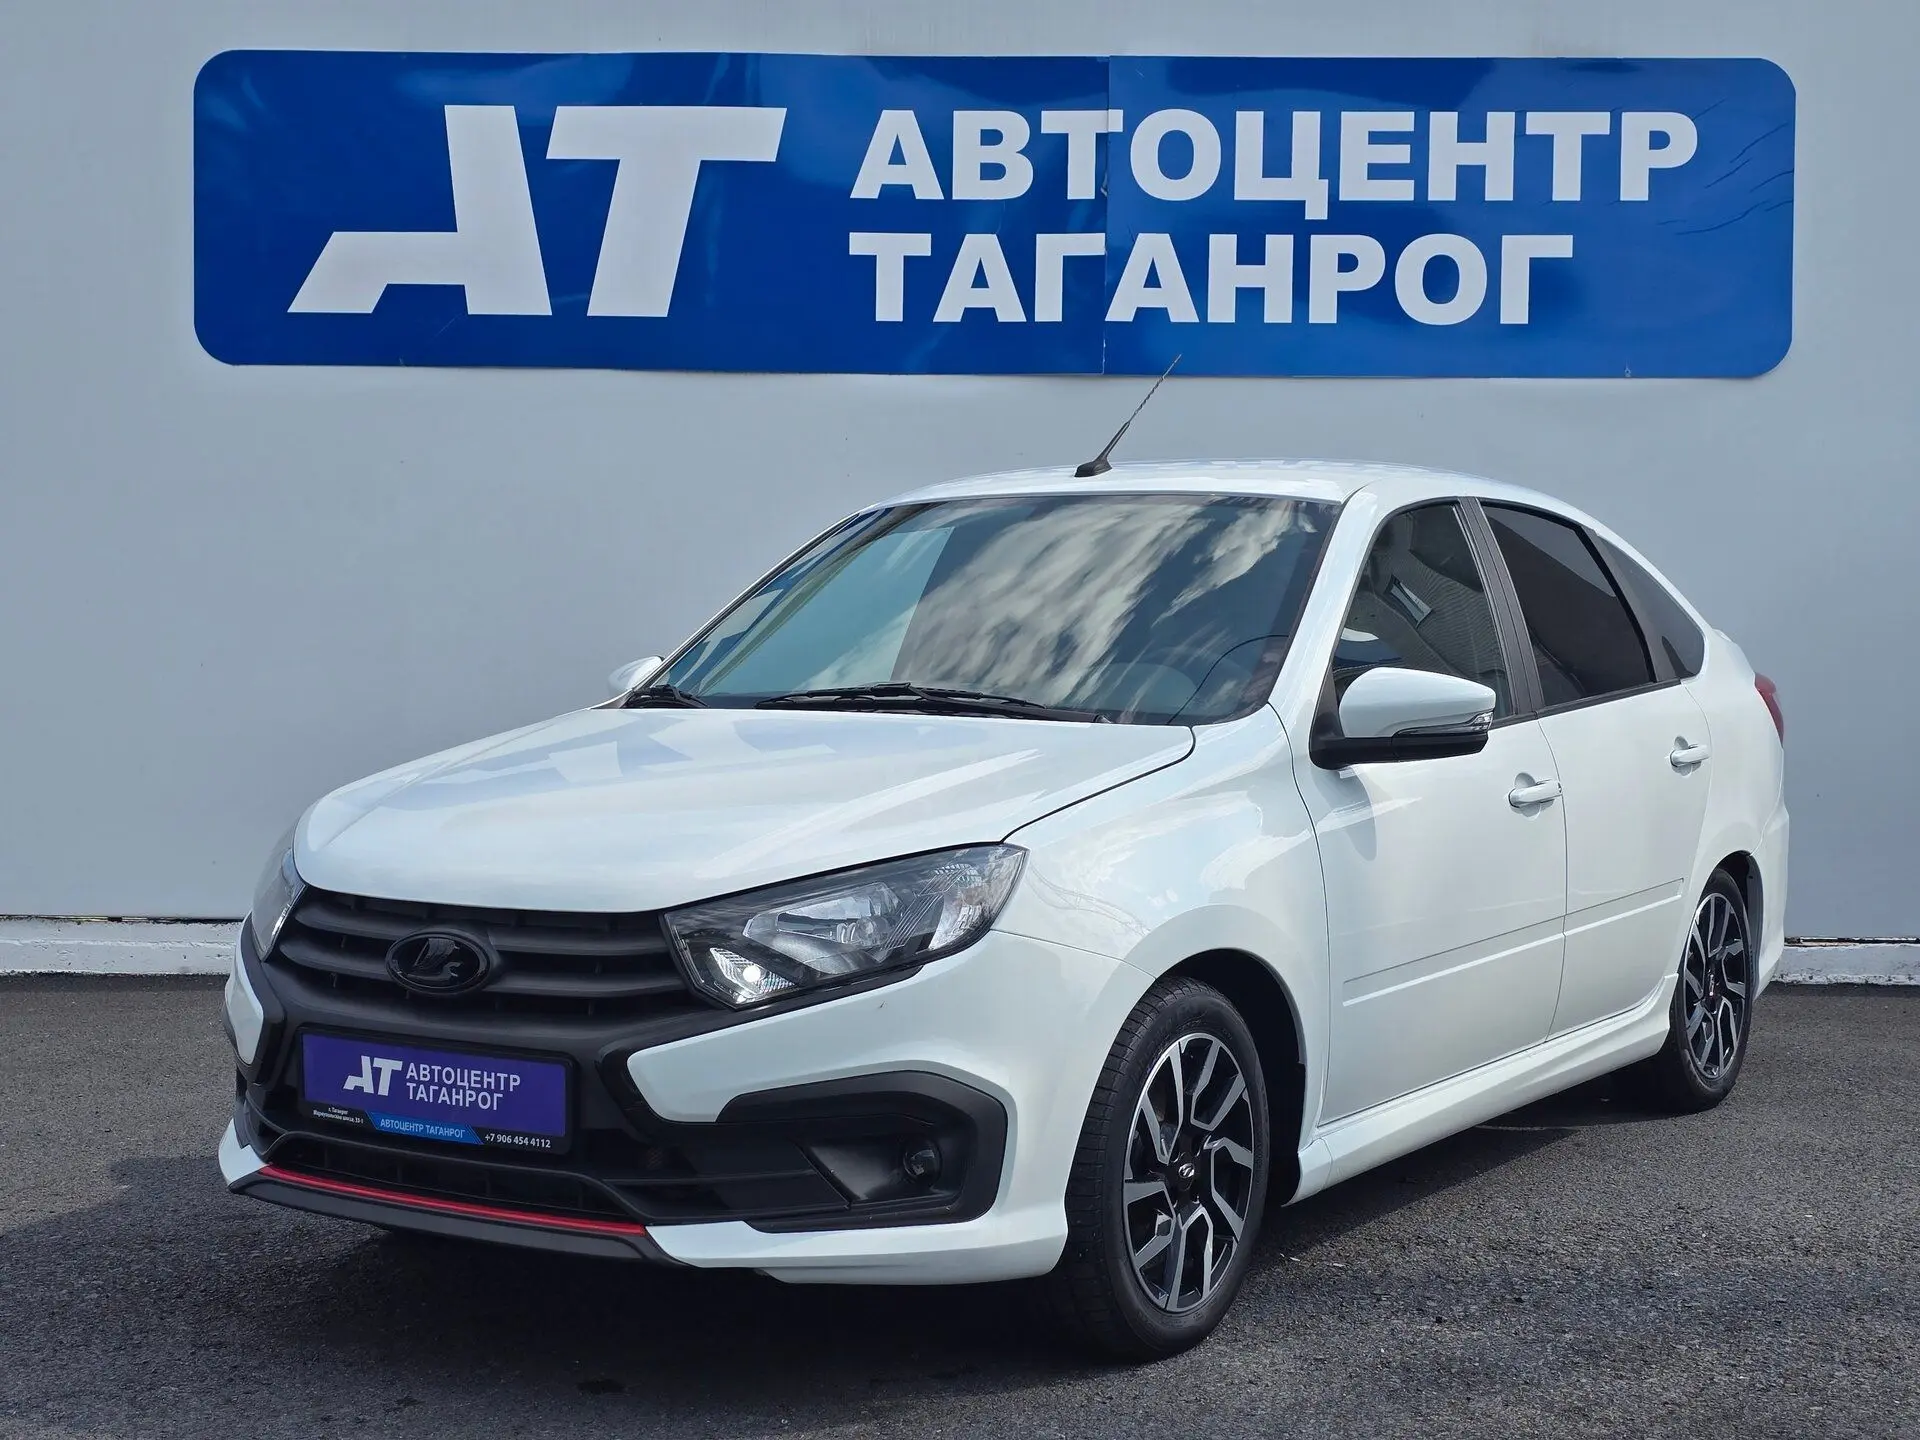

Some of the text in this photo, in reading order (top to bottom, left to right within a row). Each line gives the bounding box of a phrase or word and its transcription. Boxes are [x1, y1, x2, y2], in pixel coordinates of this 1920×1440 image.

[849, 108, 1699, 221] АВТОЦЕНТР
[287, 105, 788, 317] АТ
[849, 232, 1574, 326] ТАГАНРОГ
[406, 1062, 521, 1092] АВТОЦЕНТР
[406, 1083, 504, 1111] ТАГАНРОГ
[380, 1118, 466, 1139] АВТОЦЕНТР ТАГАНРОГ
[484, 1133, 551, 1148] +7 906 454 4112
